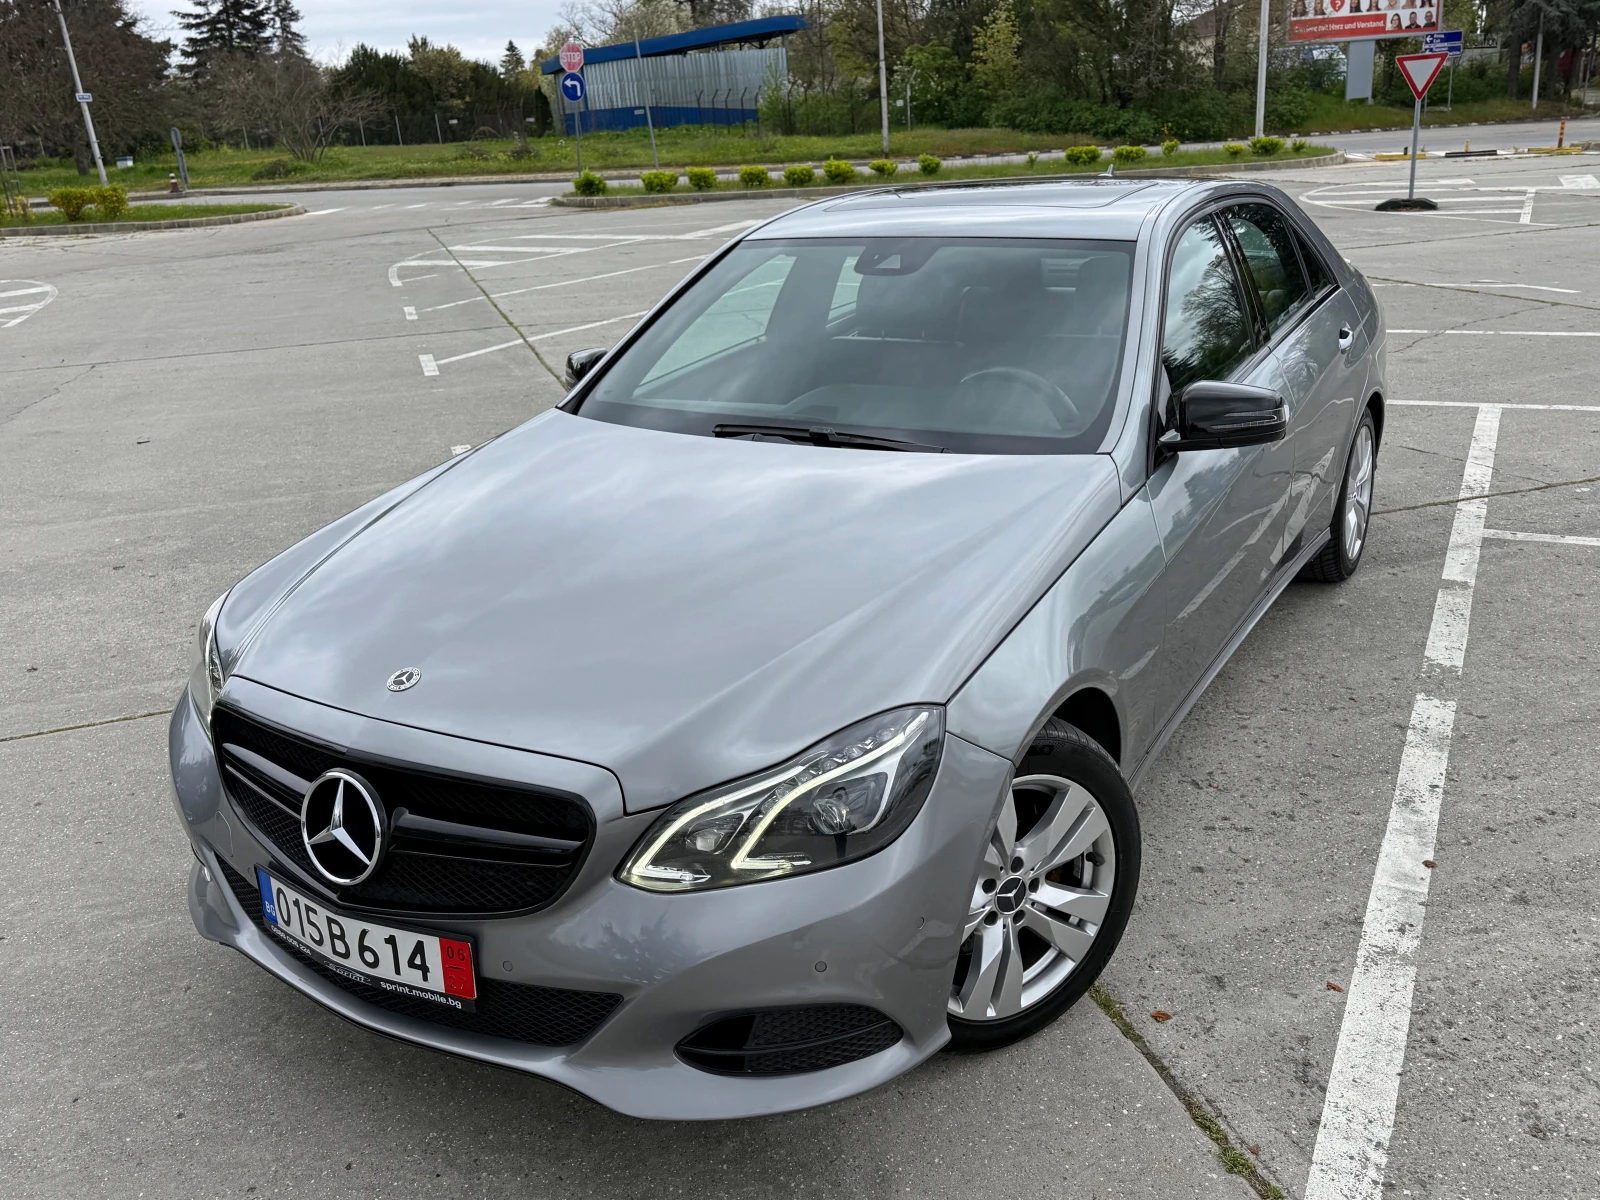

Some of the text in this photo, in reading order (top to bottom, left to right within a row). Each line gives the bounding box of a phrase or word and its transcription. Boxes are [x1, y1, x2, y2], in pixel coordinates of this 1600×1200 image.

[1329, 22, 1344, 31] Herz
[1344, 22, 1356, 30] und
[1356, 19, 1385, 29] Verstand.
[562, 52, 580, 63] STOP
[265, 901, 275, 916] BG
[446, 945, 466, 962] 06
[447, 974, 467, 990] 27
[380, 981, 462, 1009] sprint.mobile.bg
